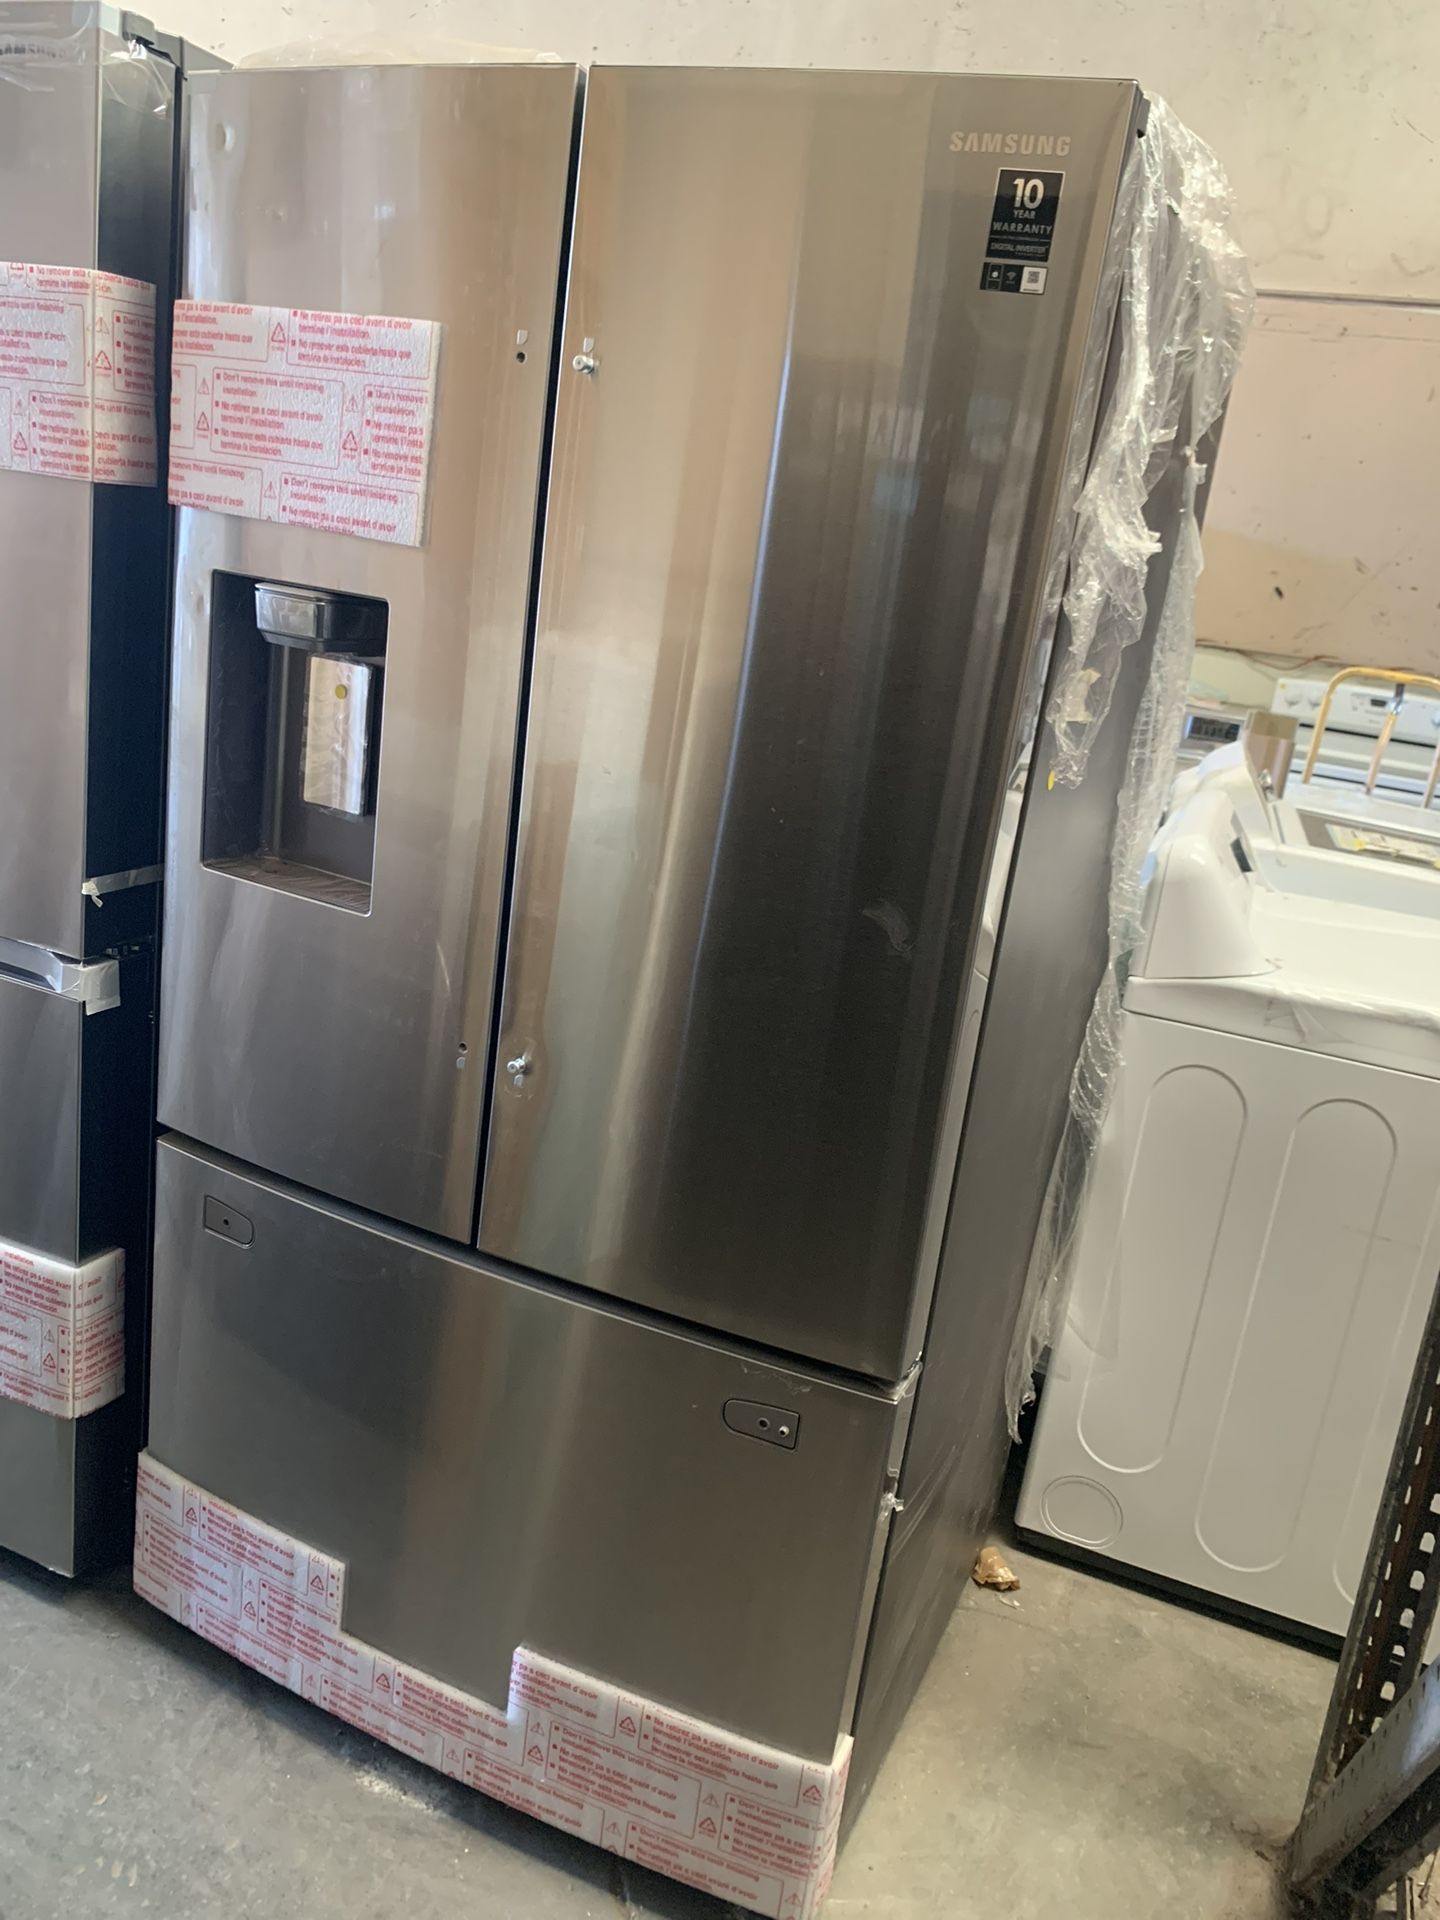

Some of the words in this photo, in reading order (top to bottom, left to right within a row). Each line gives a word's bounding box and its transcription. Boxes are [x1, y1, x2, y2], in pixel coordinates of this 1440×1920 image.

[950, 131, 1072, 156] SAMSUNG
[1014, 178, 1044, 209] 10
[1013, 210, 1036, 219] YEAR
[993, 222, 1053, 234] WARRANTY
